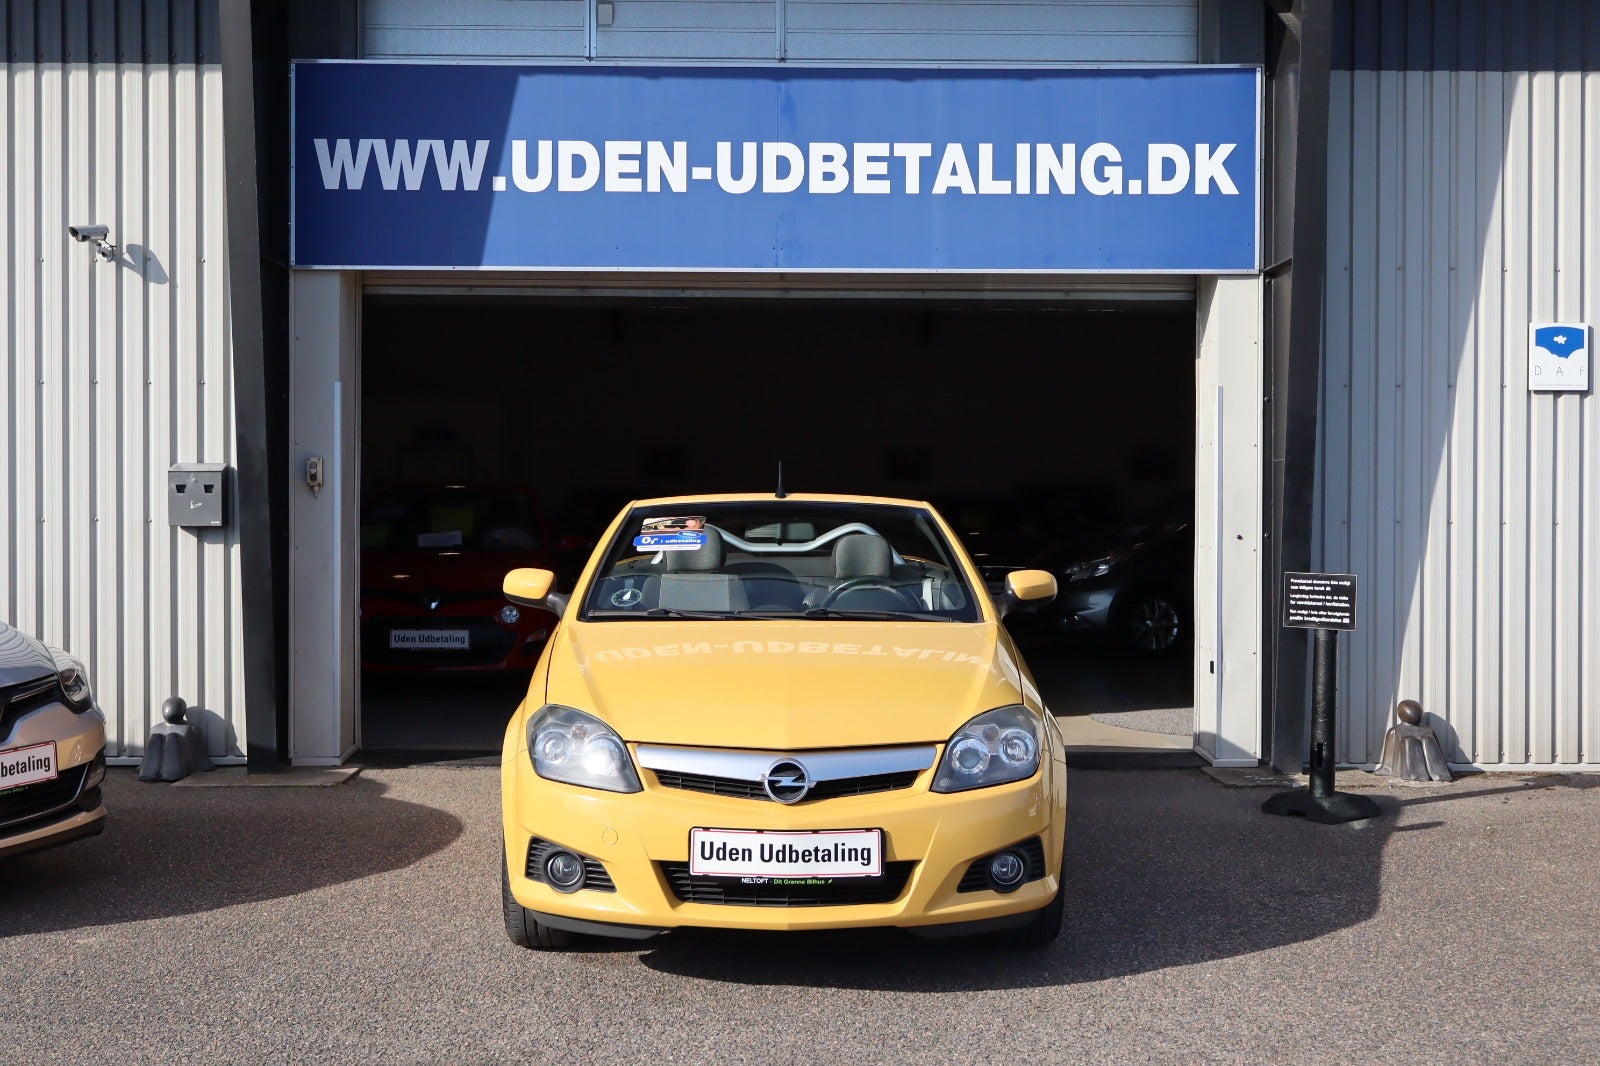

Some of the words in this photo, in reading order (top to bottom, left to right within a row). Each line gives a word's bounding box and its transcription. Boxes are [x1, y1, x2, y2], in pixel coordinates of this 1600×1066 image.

[314, 138, 1239, 196] WWW.UDEN-UDBETALING.DK
[393, 633, 416, 644] Uden
[418, 633, 466, 645] Udbetaling
[700, 840, 753, 862] Uden
[760, 842, 872, 867] Udbetaling
